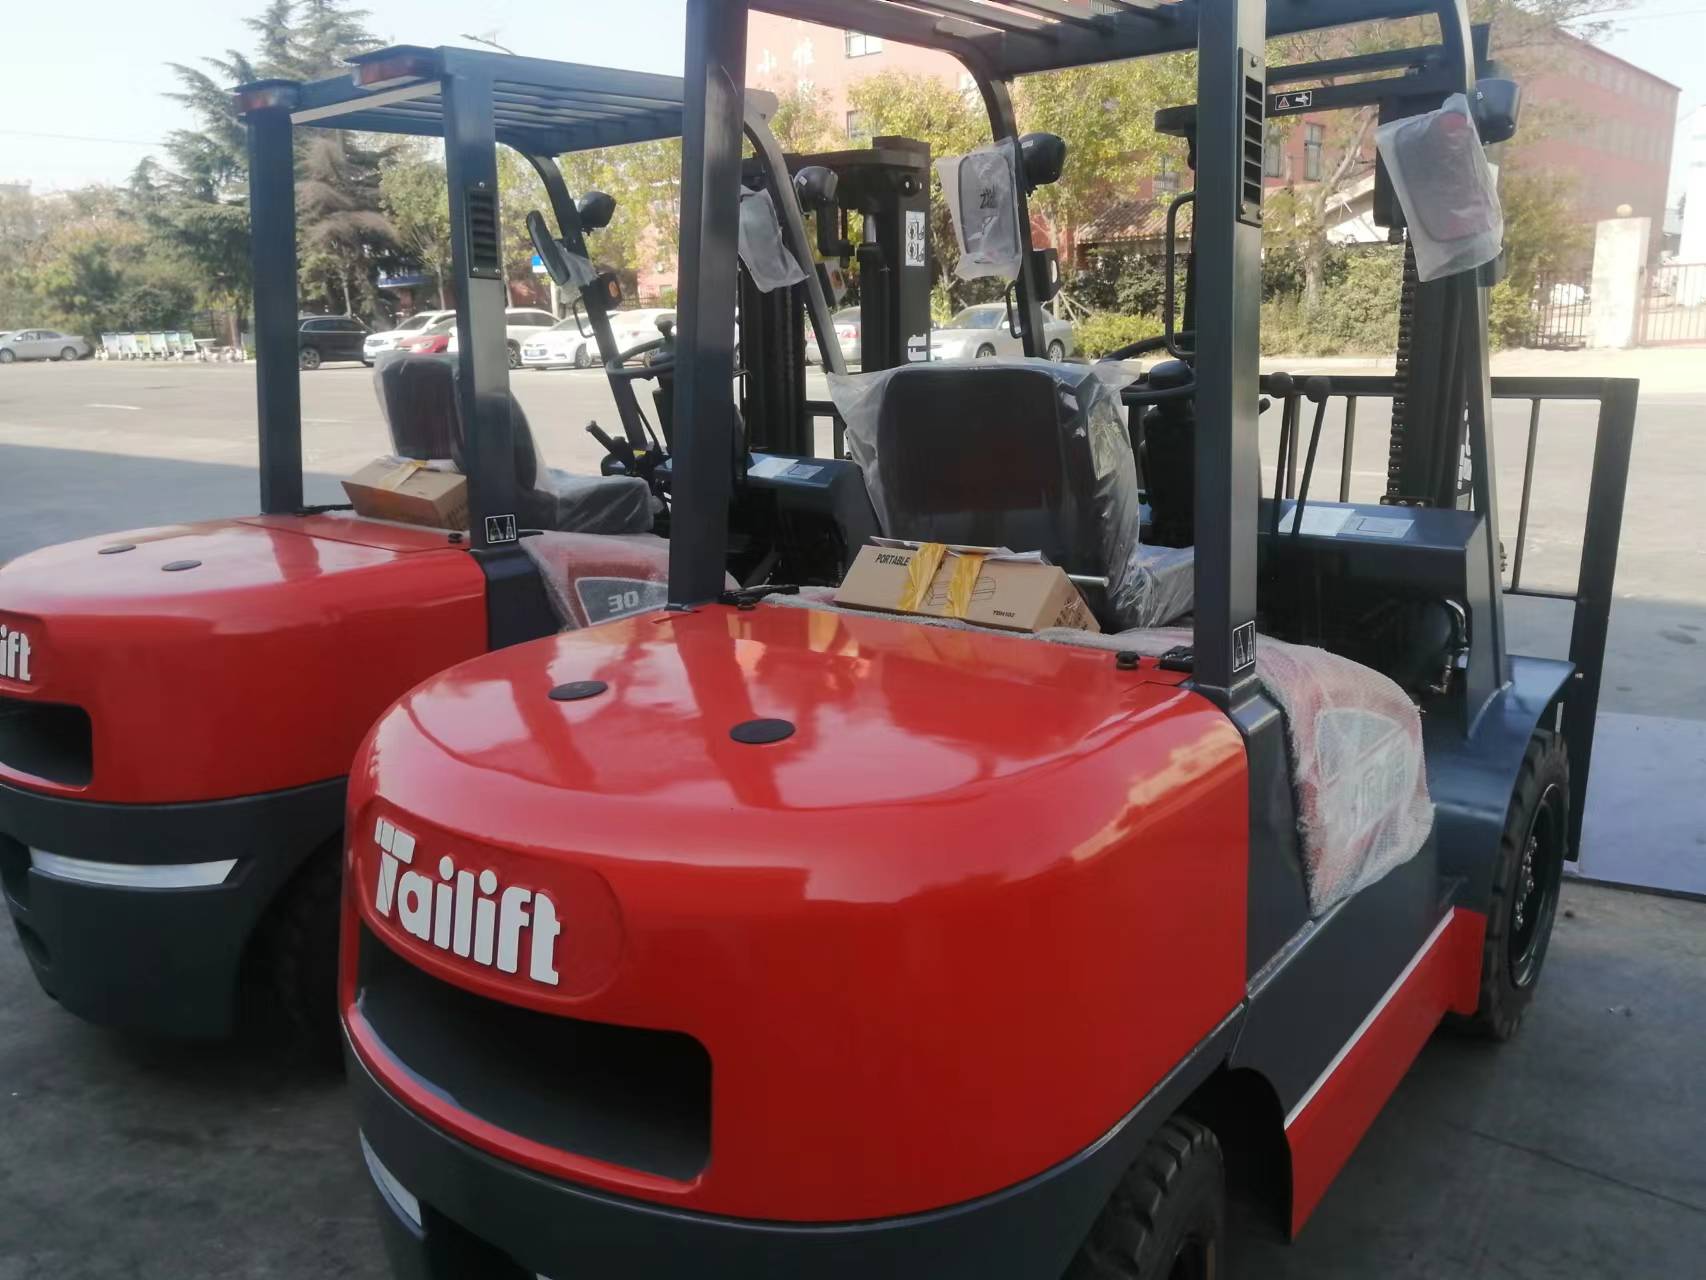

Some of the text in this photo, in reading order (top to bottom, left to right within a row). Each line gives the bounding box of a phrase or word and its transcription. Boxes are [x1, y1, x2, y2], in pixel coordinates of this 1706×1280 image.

[875, 553, 911, 567] PORTABLE
[607, 590, 640, 613] 30
[374, 816, 560, 985] Tailift
